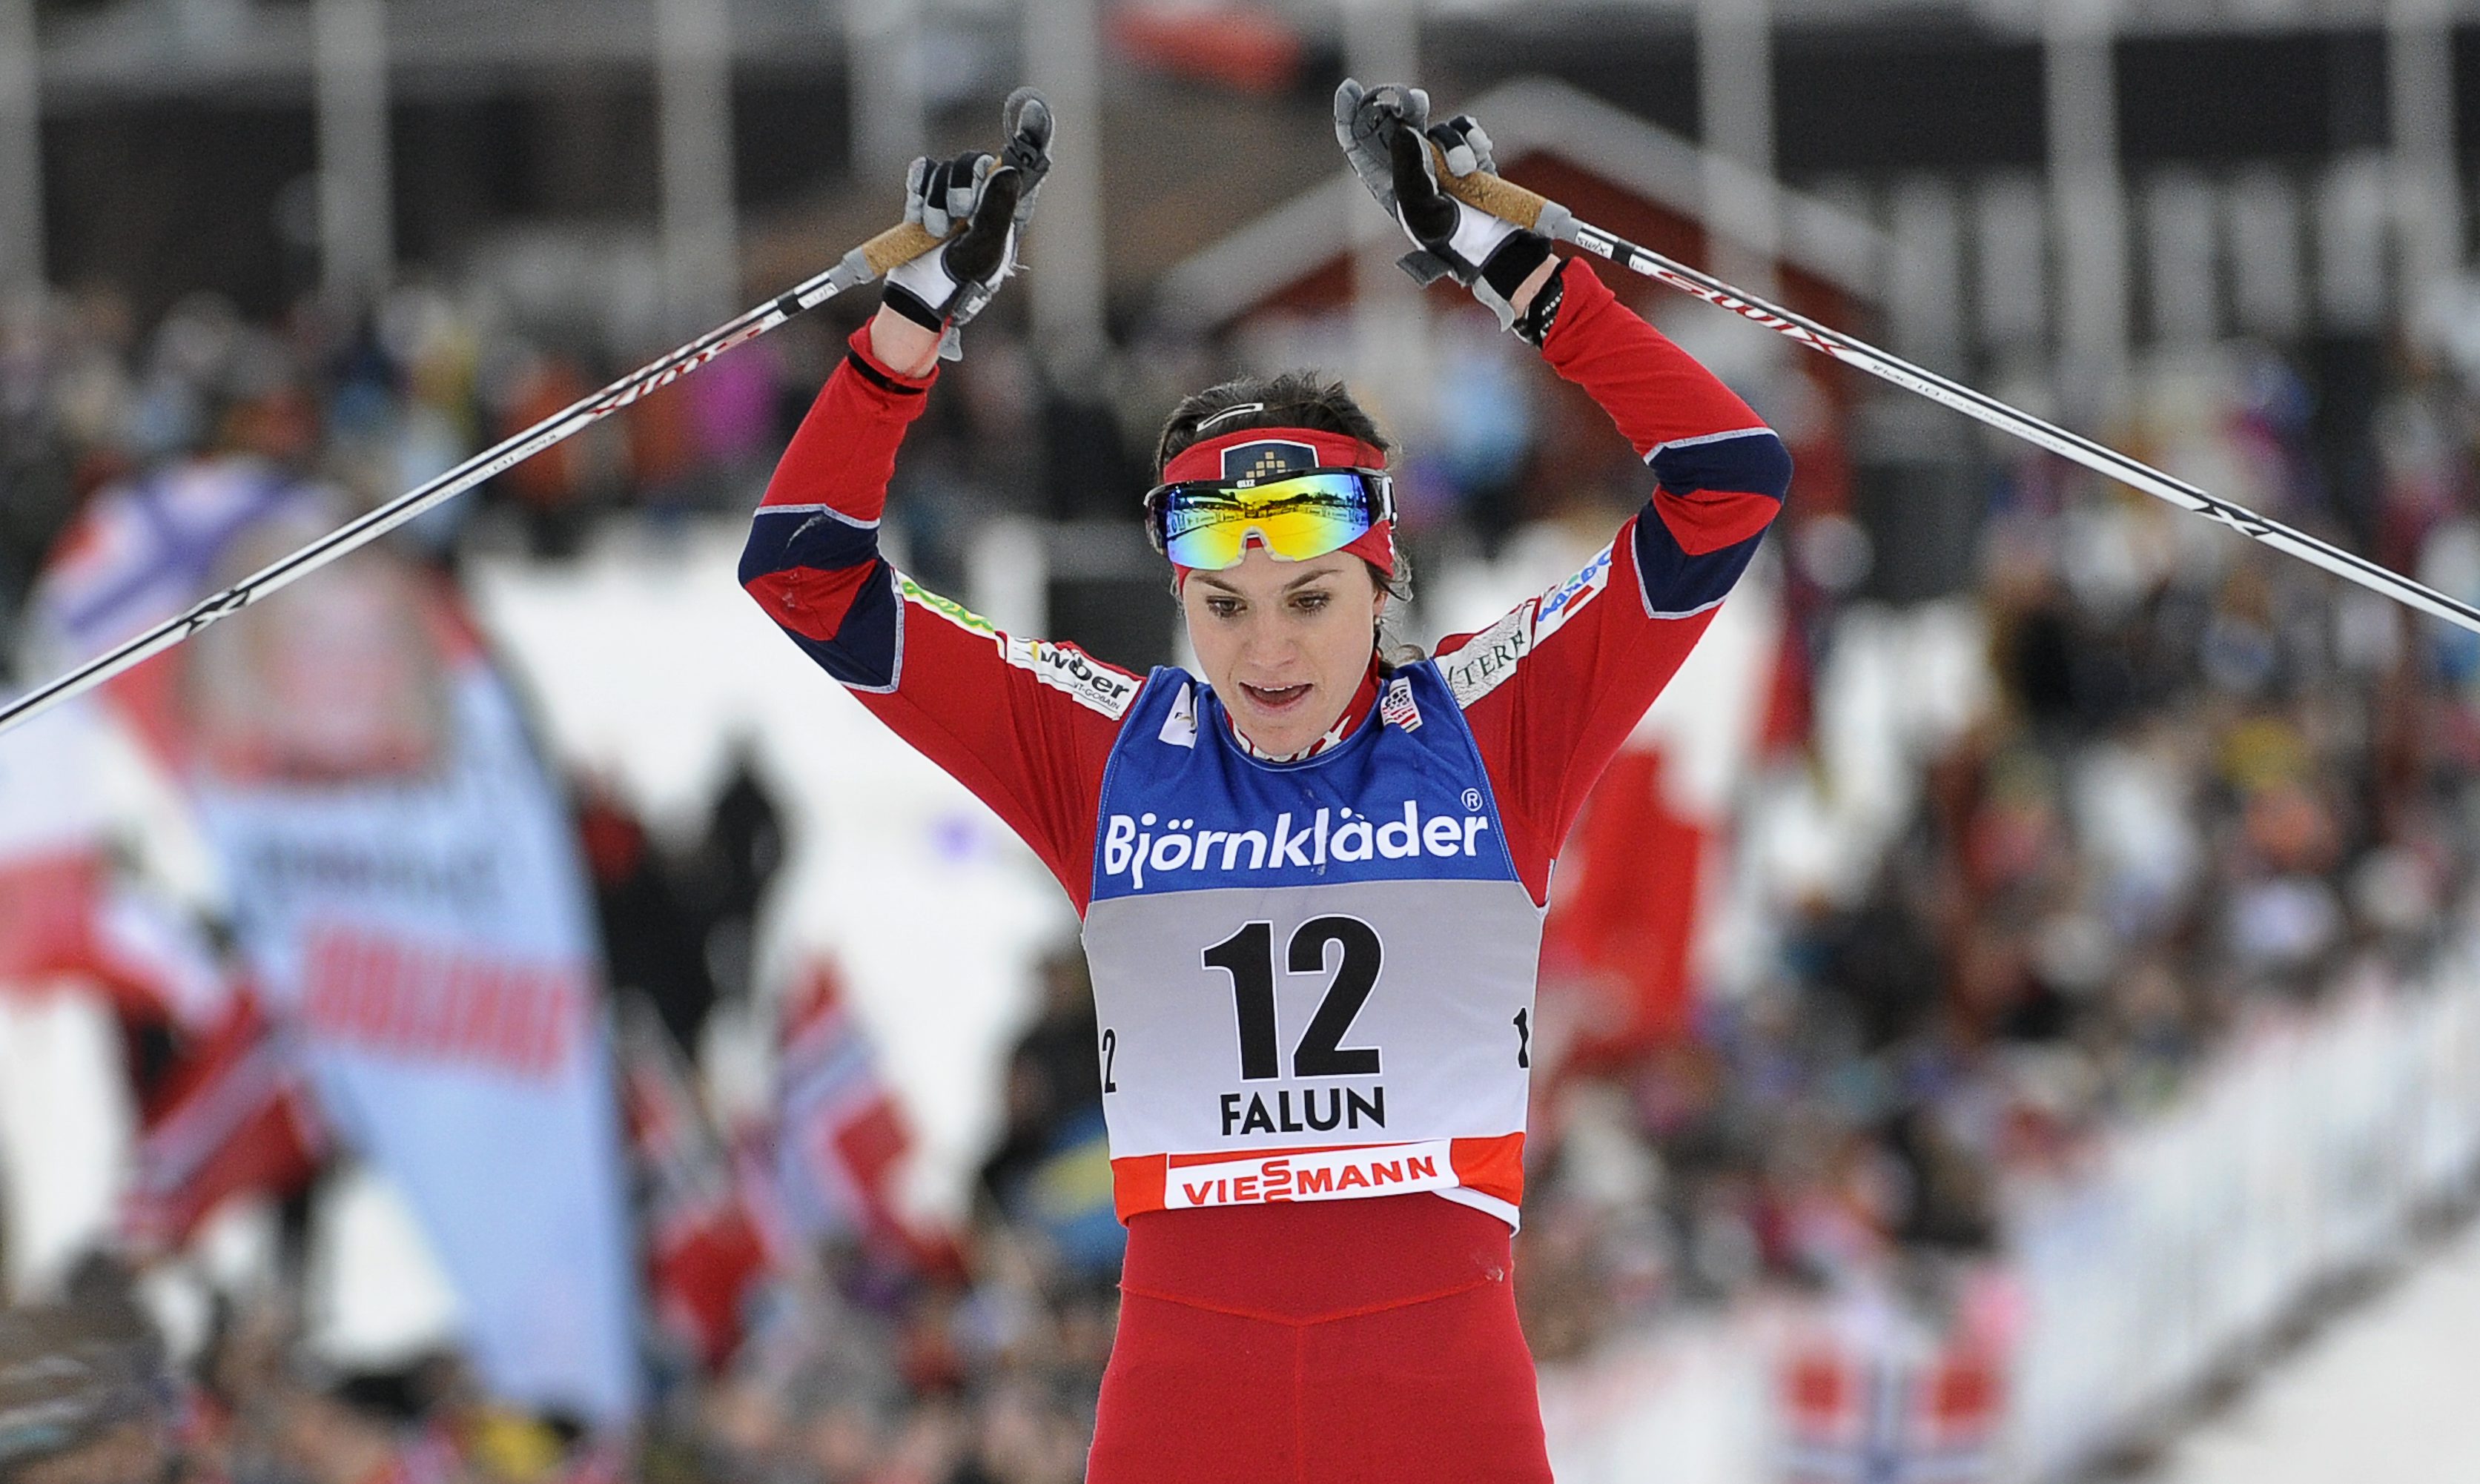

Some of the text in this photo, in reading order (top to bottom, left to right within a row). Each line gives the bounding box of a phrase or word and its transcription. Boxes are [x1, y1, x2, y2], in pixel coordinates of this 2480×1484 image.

[1105, 800, 1489, 890] Björnkläder
[1201, 915, 1383, 1081] 12
[1220, 1086, 1386, 1136] FALUN
